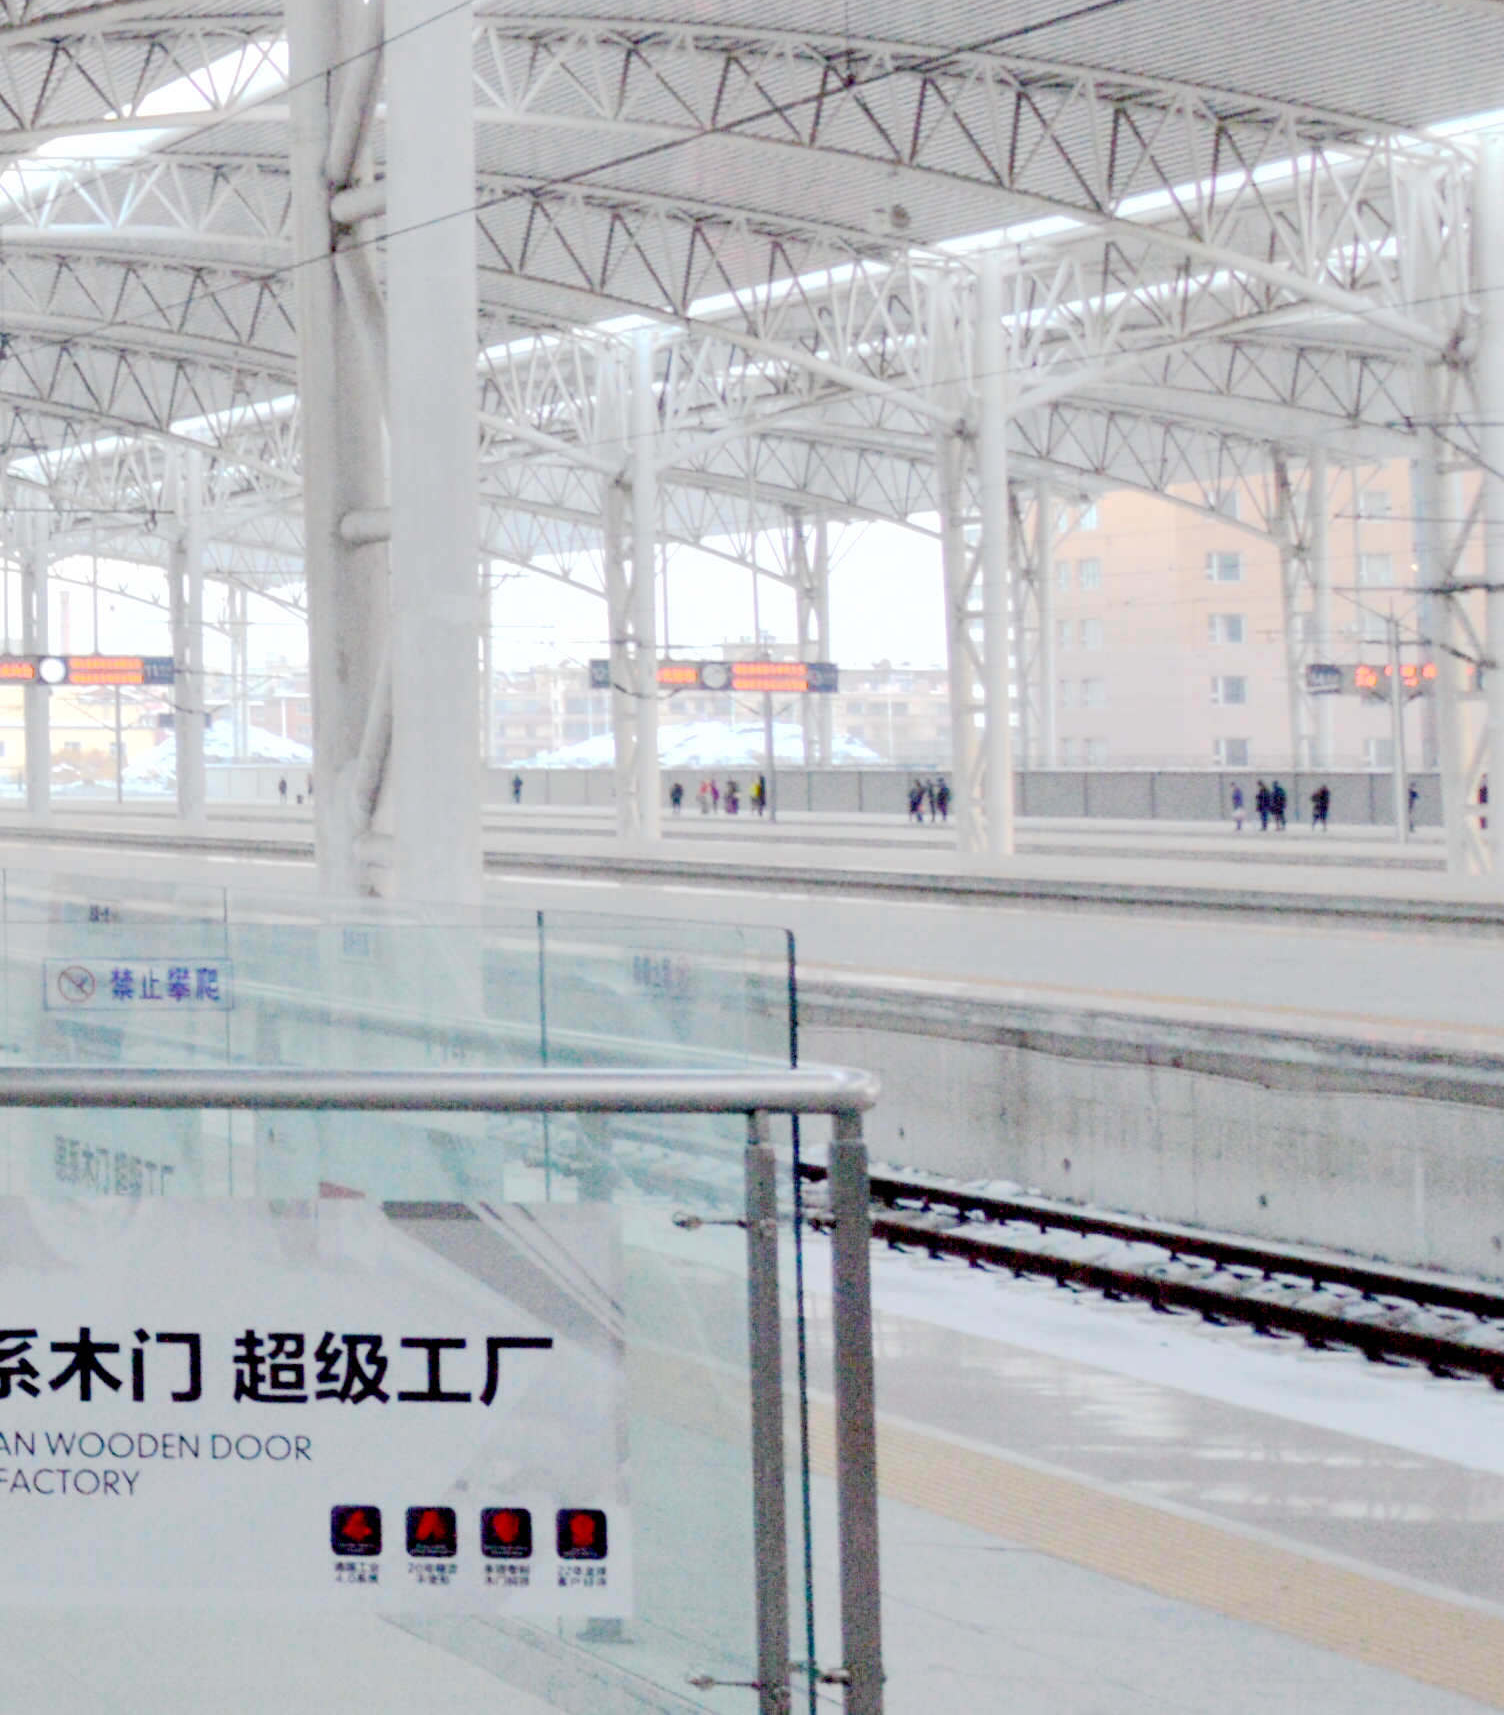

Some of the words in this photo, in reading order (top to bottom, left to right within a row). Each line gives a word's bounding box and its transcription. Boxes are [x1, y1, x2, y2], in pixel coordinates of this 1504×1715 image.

[110, 966, 221, 1002] 禁止攀爬
[231, 1328, 555, 1408] 超级工厂
[43, 1431, 201, 1460] WOODEN
[210, 1433, 314, 1462] DOOR
